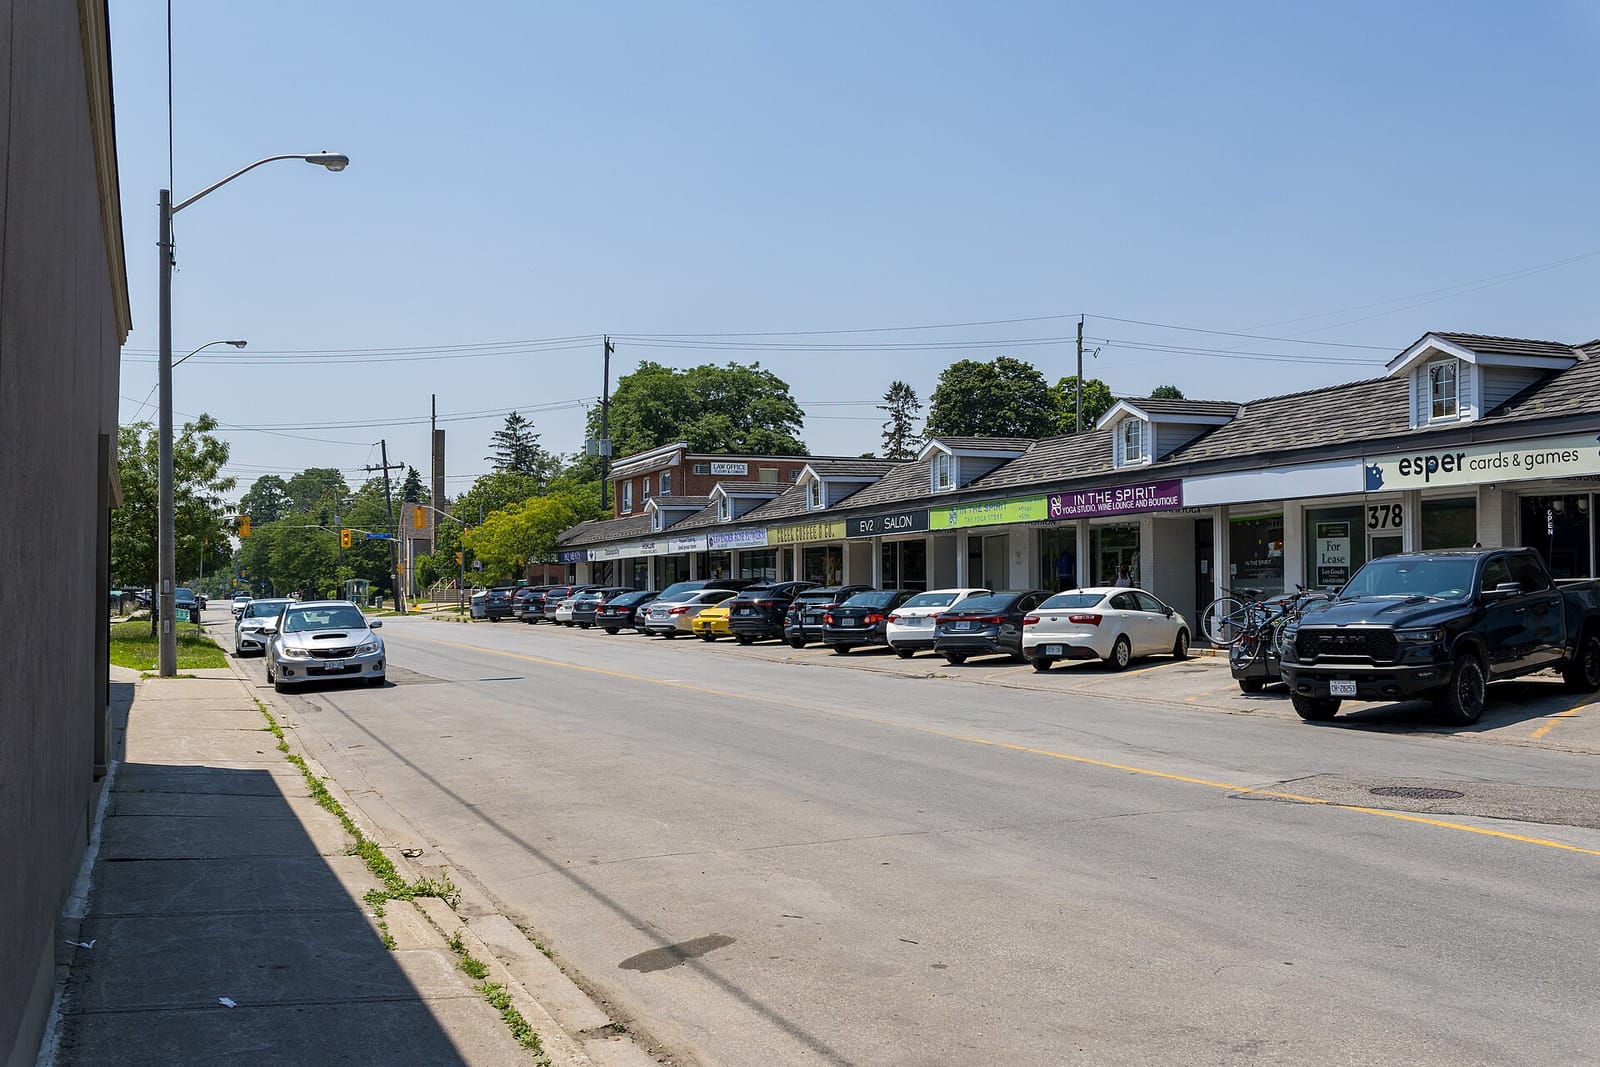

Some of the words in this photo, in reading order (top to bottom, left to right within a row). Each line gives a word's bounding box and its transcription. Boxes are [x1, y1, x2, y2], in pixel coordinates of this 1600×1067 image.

[1398, 452, 1466, 482] esper
[1469, 451, 1509, 471] cards
[1512, 453, 1521, 467] &
[1524, 449, 1579, 471] games
[1062, 505, 1077, 514] YOGA
[1098, 502, 1112, 511] WINE
[1113, 501, 1134, 510] LOUNGE
[1135, 498, 1147, 508] AND
[1148, 495, 1178, 507] BOUTIQUE
[1074, 494, 1085, 505] IN
[1087, 491, 1113, 504] THE
[1115, 486, 1157, 502] SPIRIT
[884, 515, 913, 530] SALON
[1368, 503, 1403, 529] 378
[1326, 540, 1341, 551] For
[1322, 553, 1346, 564] Lease
